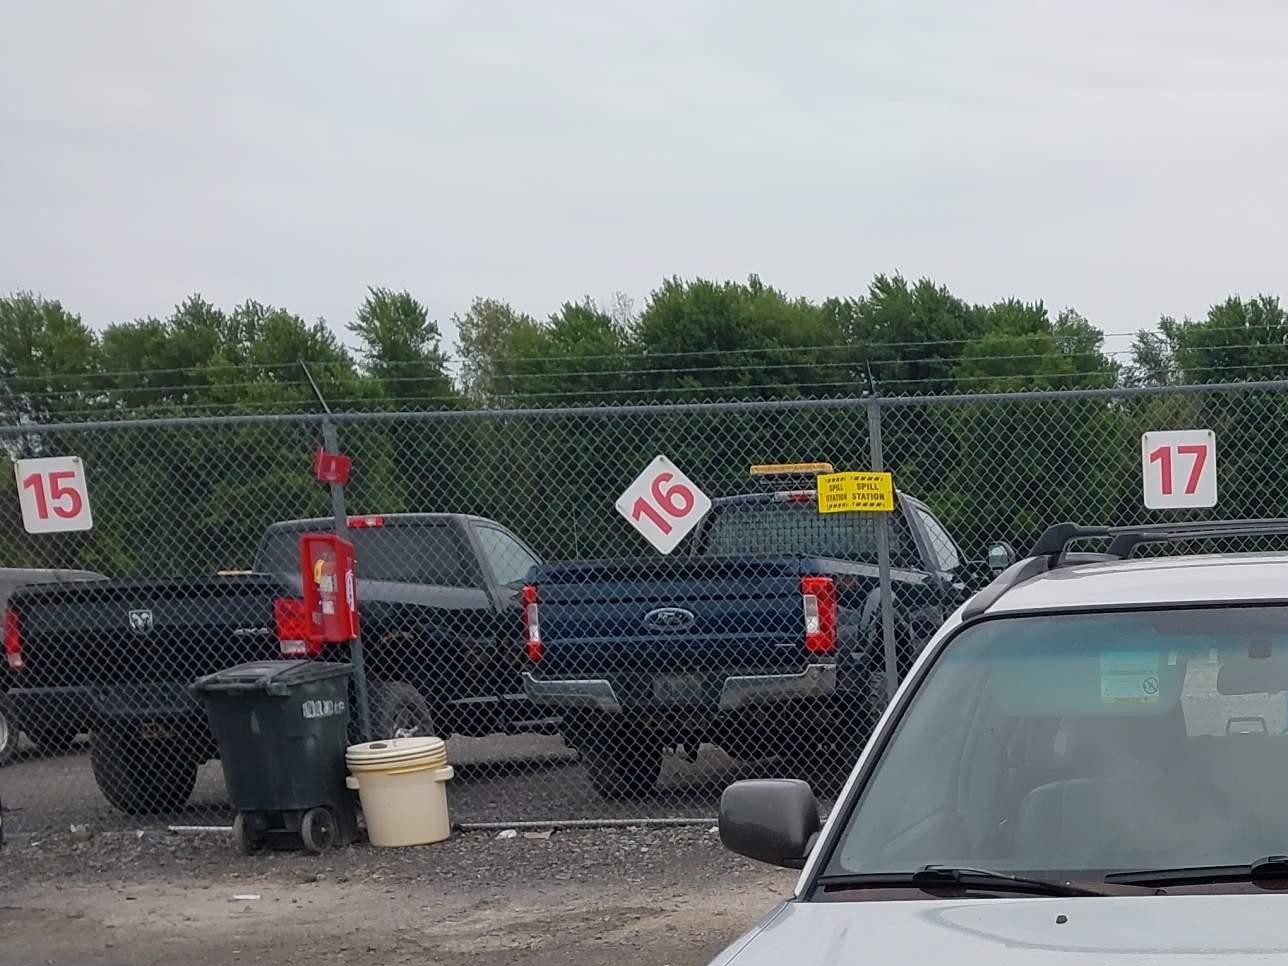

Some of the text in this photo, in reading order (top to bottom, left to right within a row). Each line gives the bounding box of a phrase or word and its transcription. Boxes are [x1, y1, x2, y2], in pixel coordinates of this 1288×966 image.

[829, 484, 844, 492] SPILL
[1150, 445, 1208, 495] 17
[23, 471, 83, 519] 15
[631, 472, 695, 535] 16
[826, 493, 847, 502] STATION
